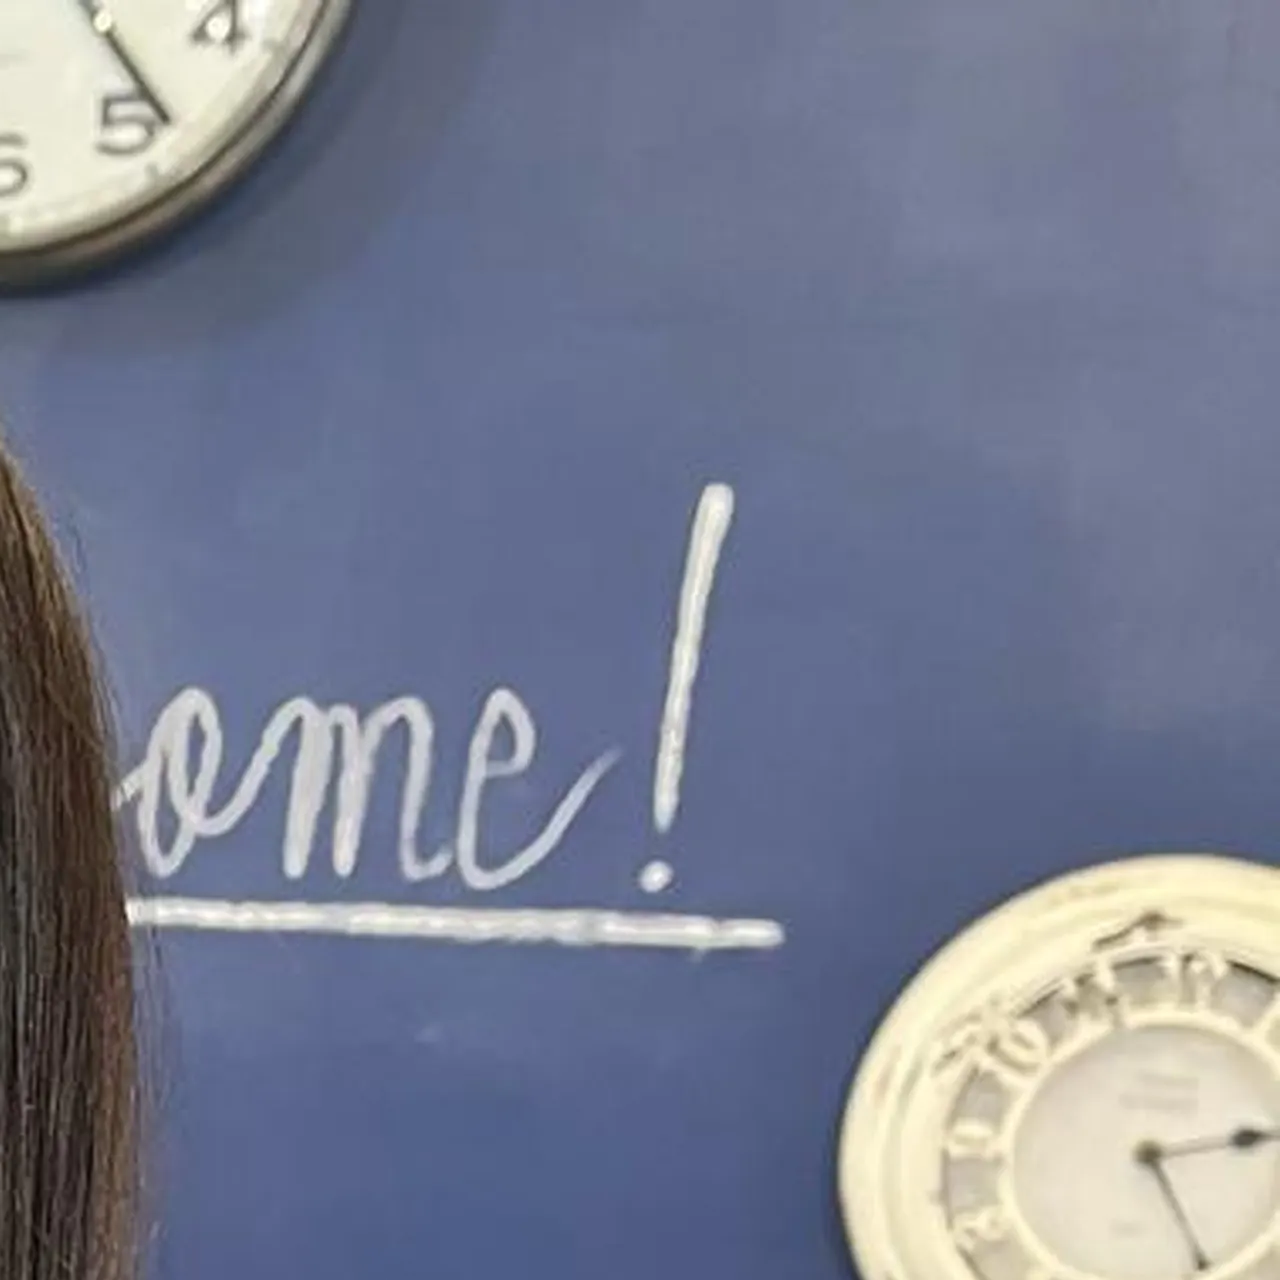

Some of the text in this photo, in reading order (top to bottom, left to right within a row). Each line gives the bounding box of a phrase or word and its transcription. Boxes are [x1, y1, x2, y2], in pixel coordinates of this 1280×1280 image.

[189, 0, 248, 52] 4
[95, 94, 157, 155] 5
[112, 482, 734, 893] ome!
